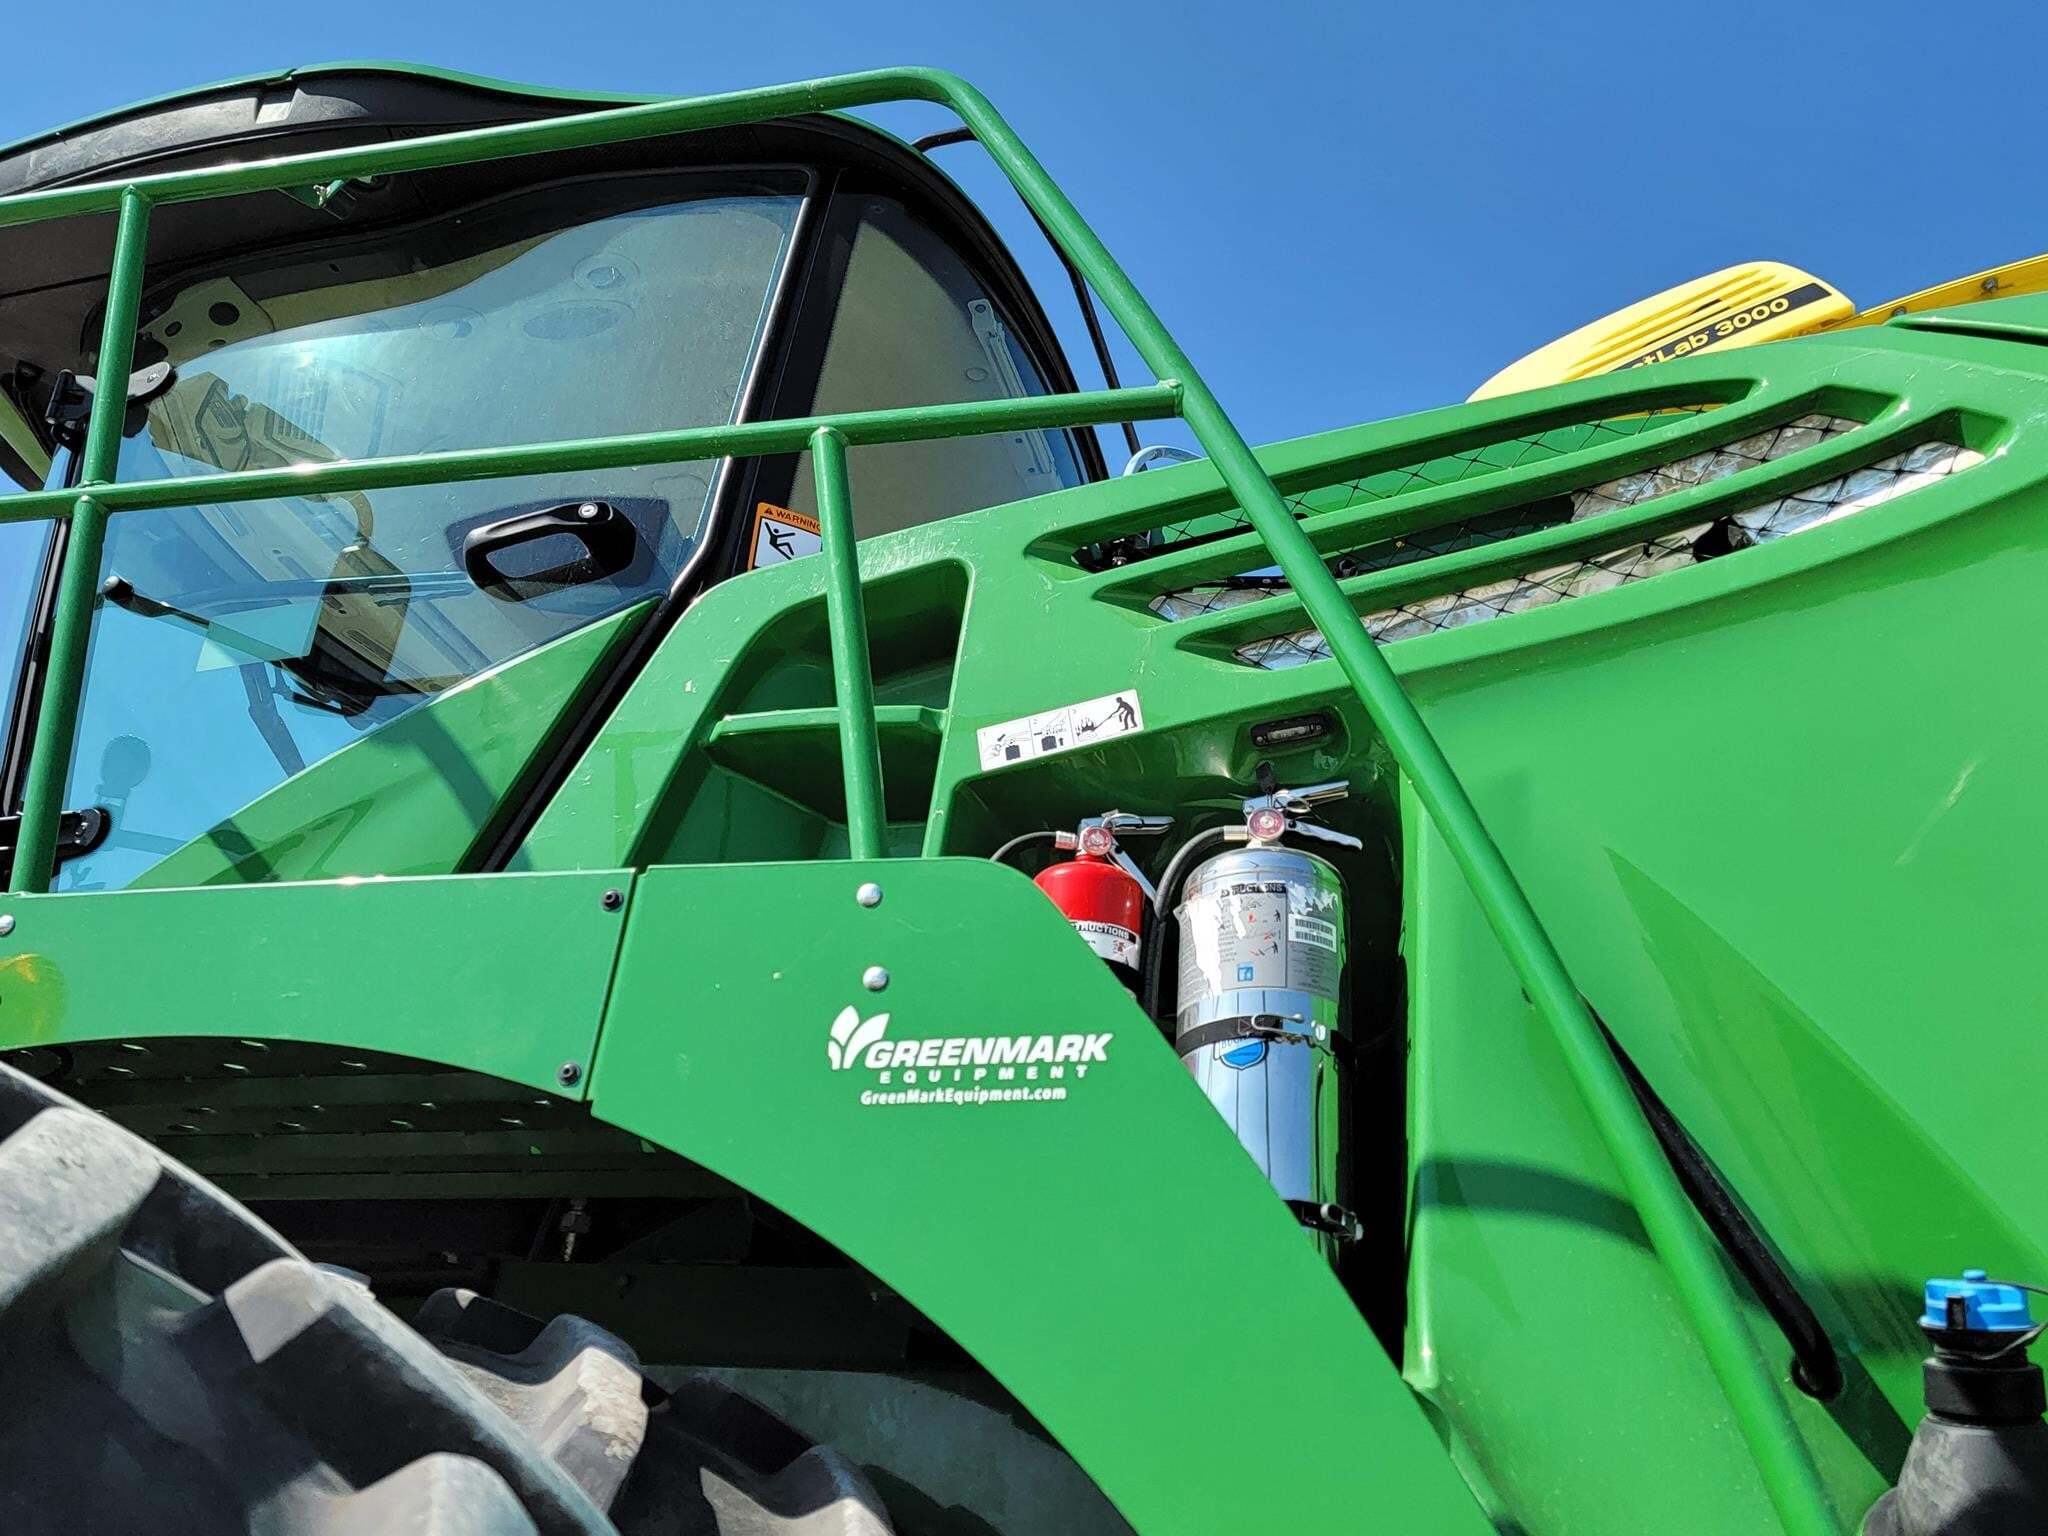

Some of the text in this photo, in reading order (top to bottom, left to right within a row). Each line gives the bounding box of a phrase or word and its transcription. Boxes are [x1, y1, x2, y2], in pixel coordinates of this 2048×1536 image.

[1714, 298, 1790, 337] 3000
[864, 1033, 1114, 1069] GREENMARK
[879, 1064, 1088, 1084] EQUIPMENT
[860, 1086, 1067, 1105] GreenMarkEquipment.com
